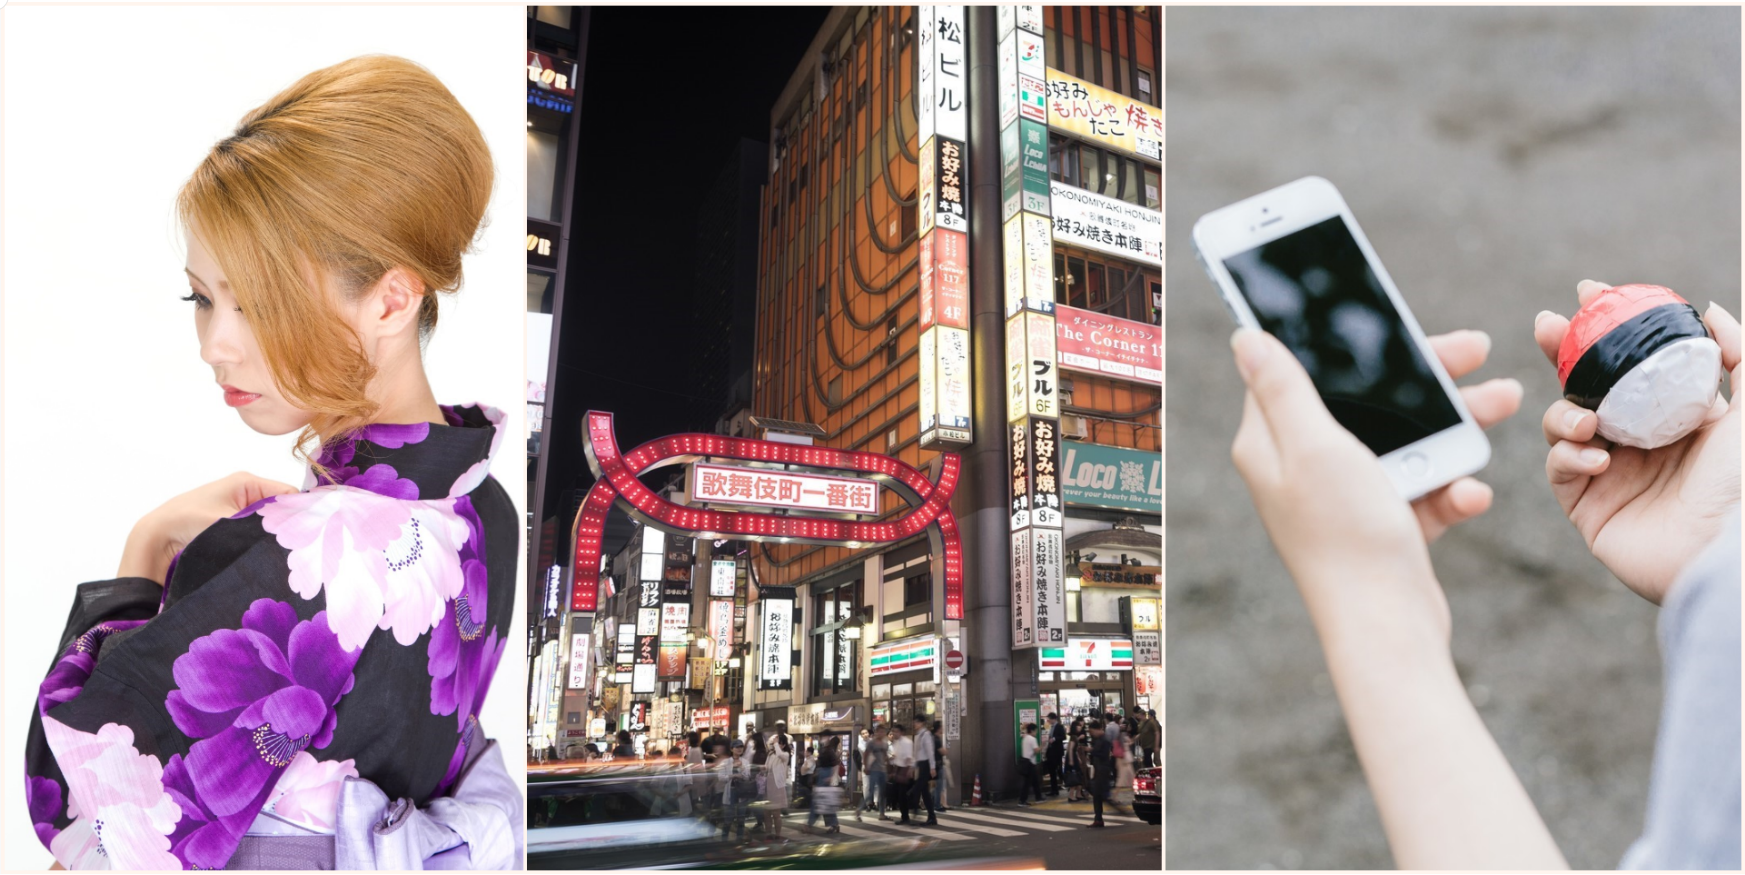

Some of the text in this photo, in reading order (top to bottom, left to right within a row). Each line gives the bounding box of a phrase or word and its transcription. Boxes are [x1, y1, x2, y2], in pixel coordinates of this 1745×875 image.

[938, 5, 962, 112] 松ビル
[1053, 99, 1117, 118] もんじゃ
[1089, 117, 1125, 136] たこ
[941, 141, 961, 202] お好み焼
[1028, 196, 1045, 210] 3F
[1051, 186, 1161, 225] OKONOMIYAKI HONJIN
[943, 214, 960, 226] 8F
[943, 273, 959, 284] 117
[944, 305, 962, 320] 4F
[1056, 323, 1084, 342] The
[1090, 331, 1146, 354] Corner
[1073, 317, 1153, 340] ダイニングレストラン
[1033, 360, 1053, 396] ブル
[1035, 399, 1051, 413] 6F
[1013, 424, 1026, 496] お好み焼
[1035, 420, 1056, 493] お好み焼
[702, 471, 872, 509] 歌舞伎町一番街
[1102, 491, 1128, 502] beauty
[1129, 494, 1143, 502] like
[1039, 509, 1055, 523] 8F
[1036, 540, 1048, 630] お好み焼き本陣
[1052, 629, 1062, 640] 2F
[573, 637, 586, 684] 劇場通り
